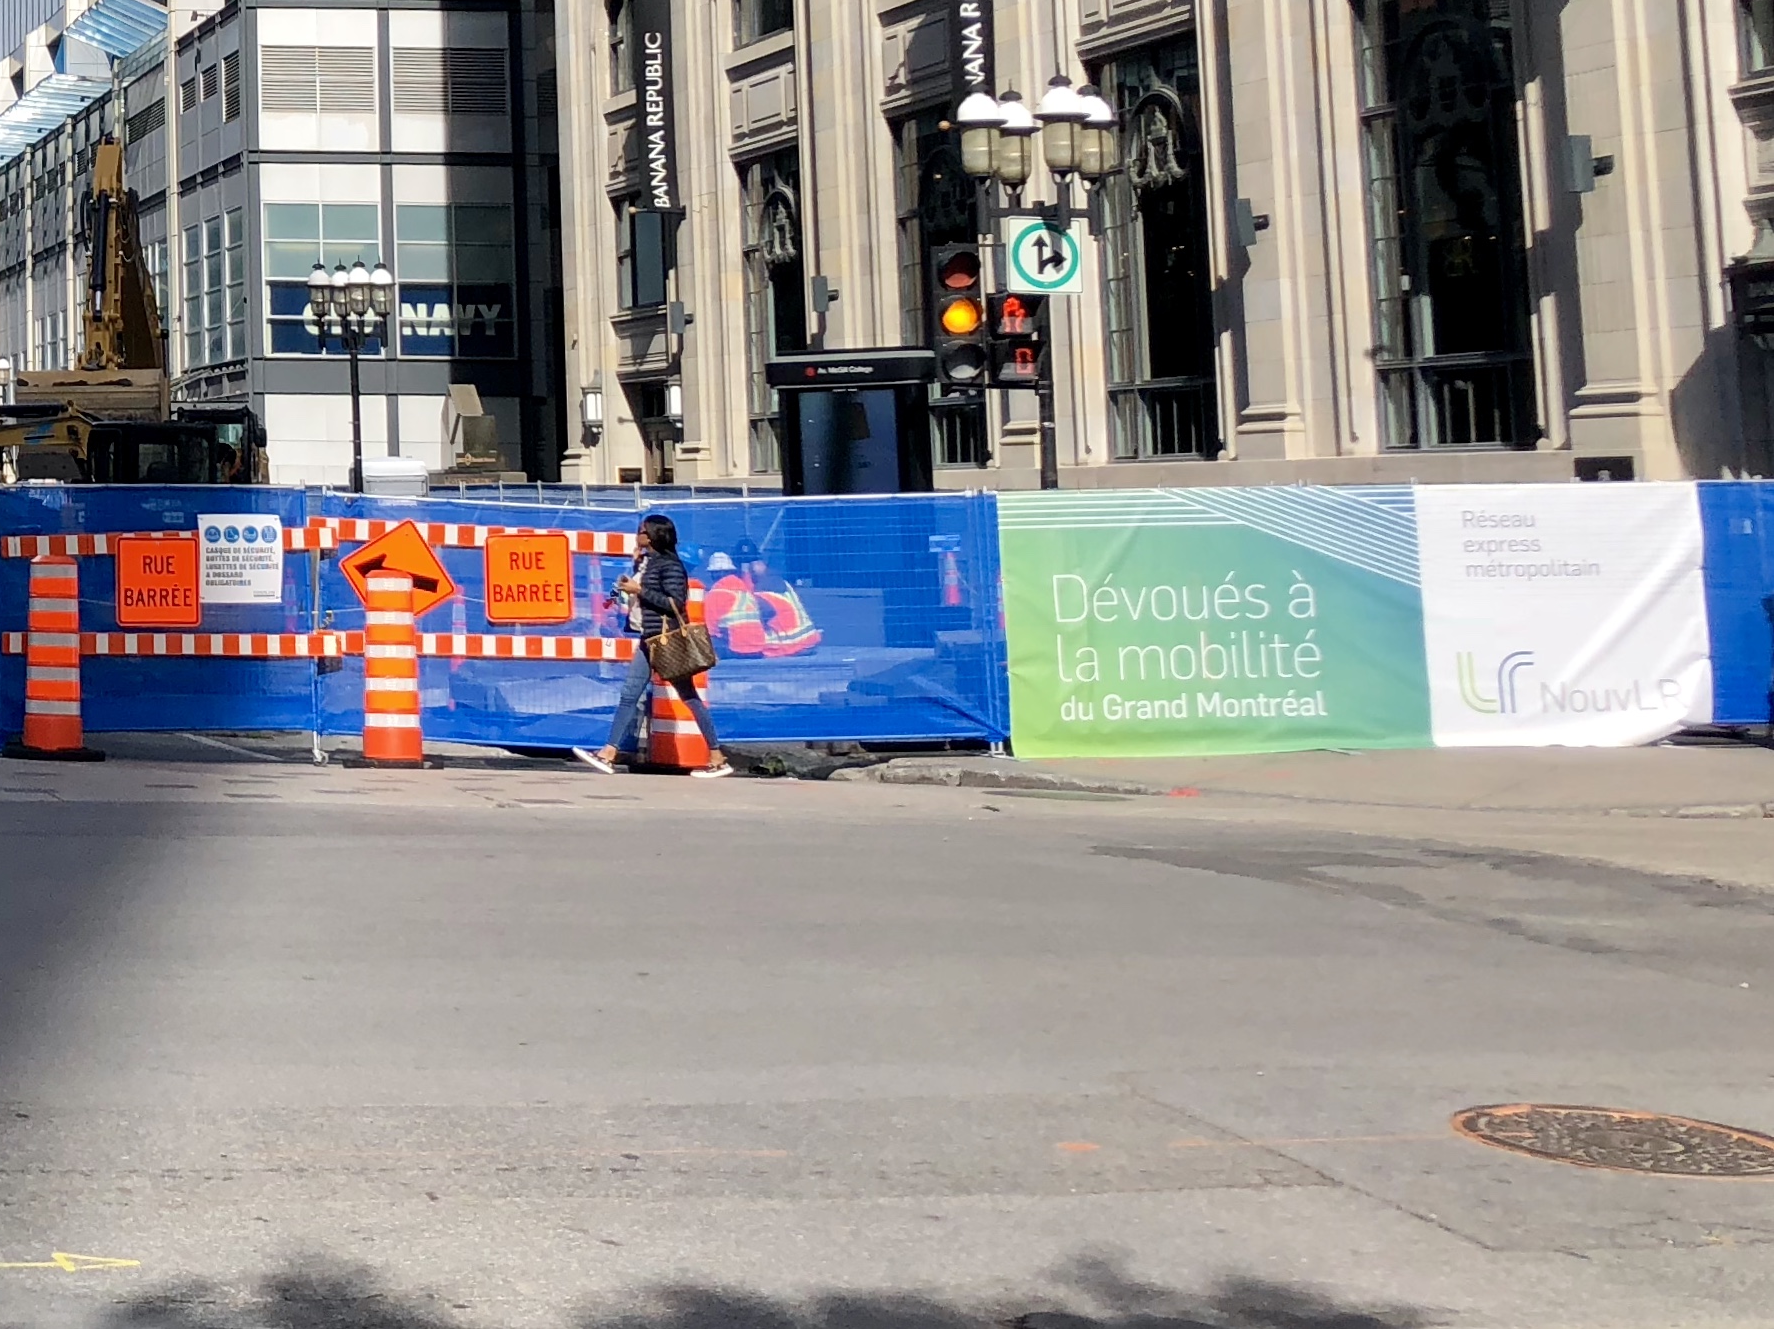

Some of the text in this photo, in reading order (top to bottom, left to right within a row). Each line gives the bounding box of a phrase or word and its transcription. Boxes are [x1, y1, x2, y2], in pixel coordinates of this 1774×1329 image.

[961, 22, 985, 85] NANA
[644, 32, 670, 208] BANANA REPUBLIC
[400, 303, 501, 336] NAVY
[1461, 510, 1536, 529] Réseau
[205, 547, 232, 555] CASQUE
[1463, 537, 1542, 557] express
[142, 555, 176, 575] RUE
[509, 552, 545, 570] RUE
[1465, 559, 1601, 582] métropolitain
[205, 579, 252, 587] OBLIGATOIRES
[492, 580, 565, 603] BARRÉE
[124, 584, 193, 607] BARRÉE
[1052, 569, 1317, 623] Dévoués à
[1056, 629, 1322, 683] la mobilité
[1060, 690, 1329, 721] du Grand Montréal
